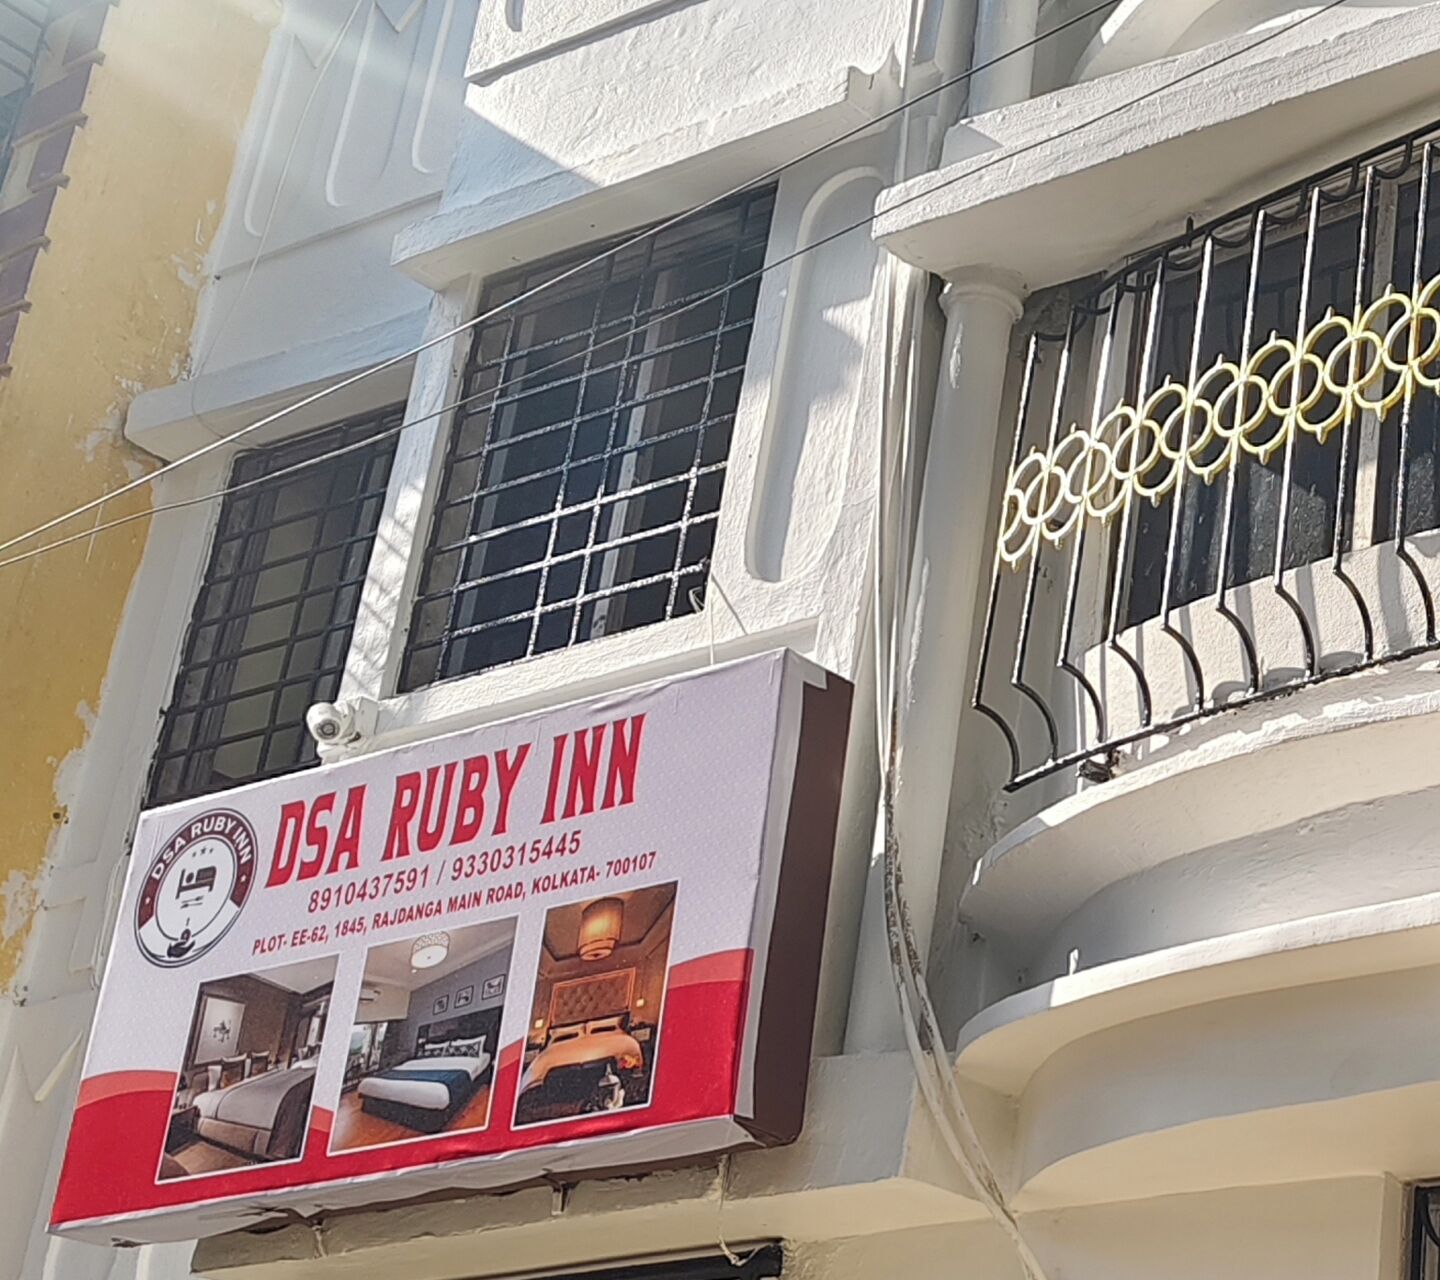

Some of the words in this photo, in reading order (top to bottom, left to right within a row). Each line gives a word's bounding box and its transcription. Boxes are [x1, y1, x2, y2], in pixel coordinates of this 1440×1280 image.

[151, 836, 187, 881] DSA
[190, 816, 236, 839] RUBY
[232, 827, 253, 865] INN
[265, 784, 368, 890] DSA
[381, 742, 532, 860] RUBY
[540, 713, 647, 825] INN
[252, 934, 287, 955] PLOT-
[290, 926, 329, 949] EE-62,
[335, 916, 368, 938] 1845,
[372, 899, 442, 930] RAJDANGA
[446, 887, 482, 914] MAIN
[486, 881, 526, 906] ROAD,
[531, 864, 601, 895] KOLKATA-
[605, 851, 657, 879] 700107
[307, 864, 430, 914] 8910437591
[436, 860, 446, 886] /
[450, 829, 582, 881] 9330315445
